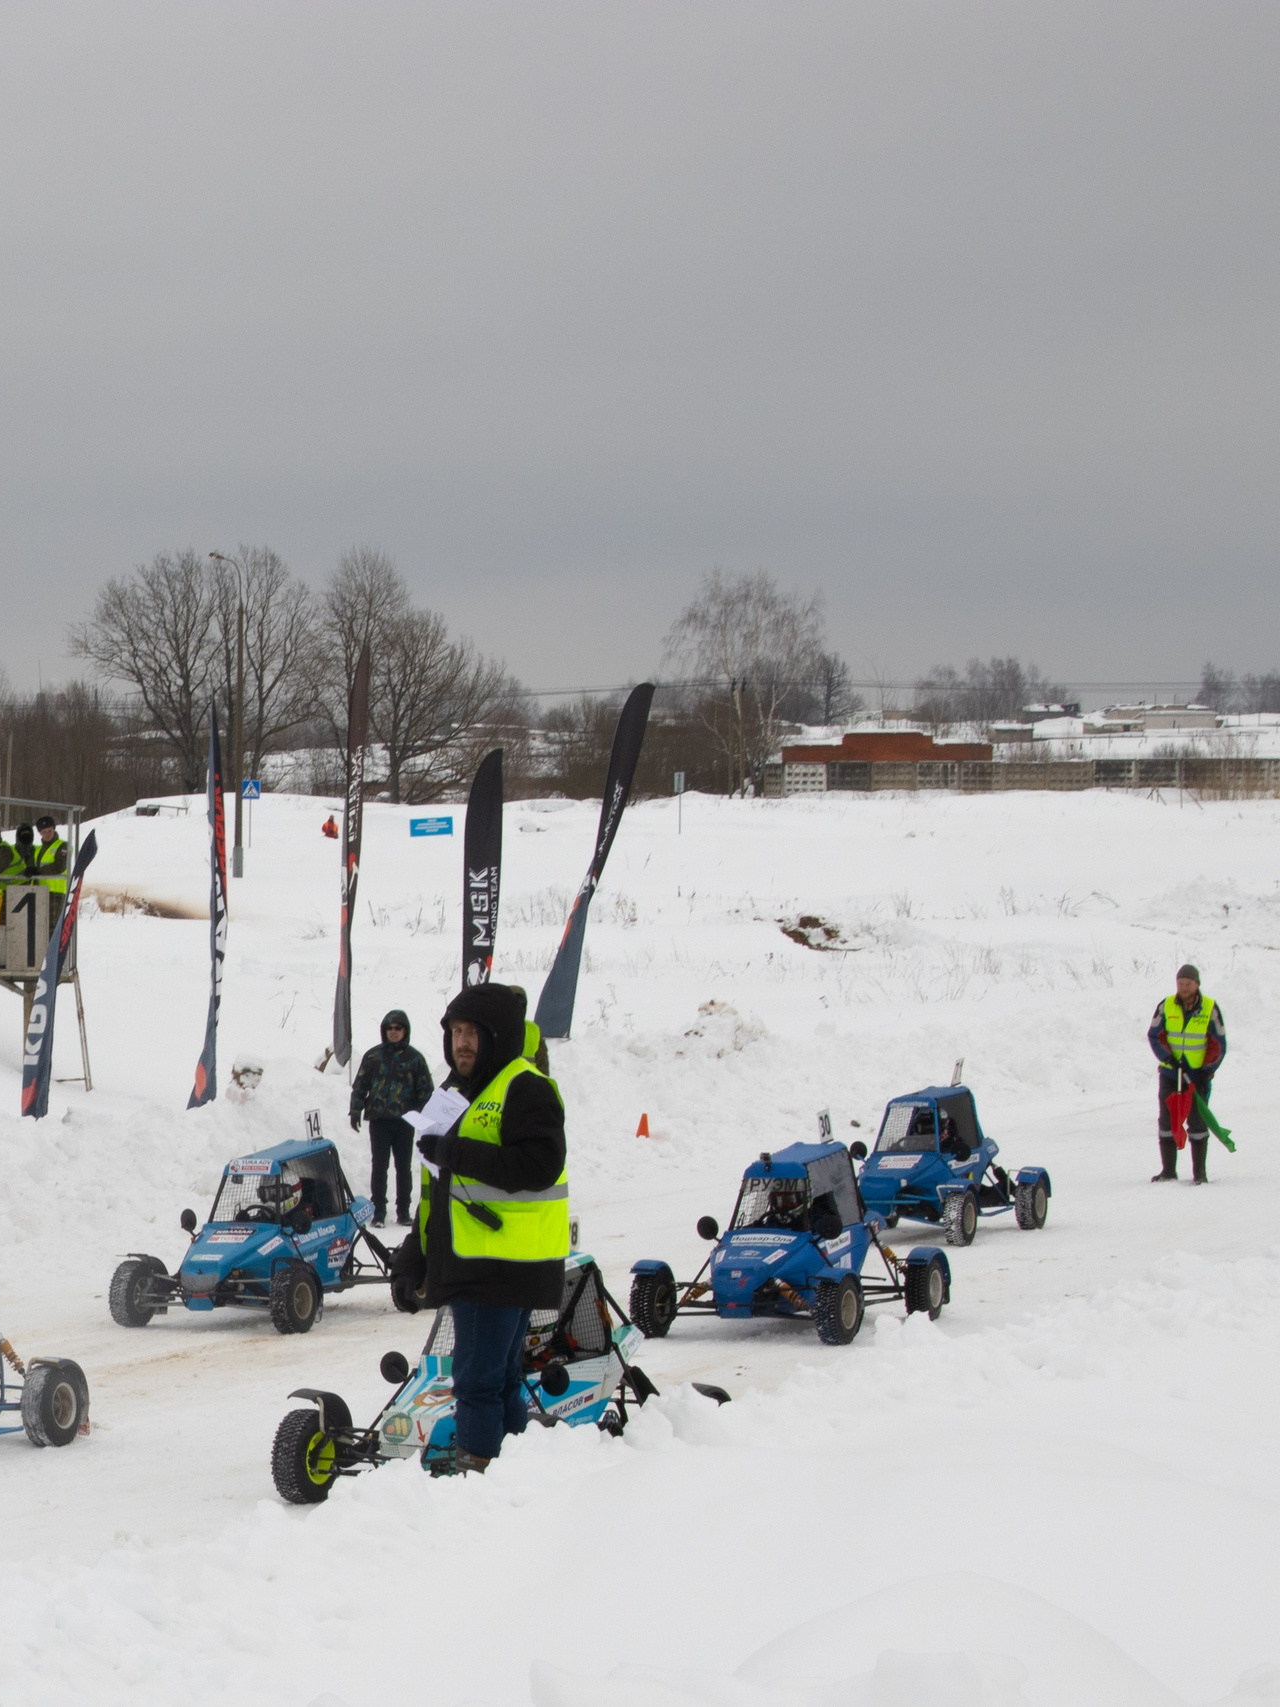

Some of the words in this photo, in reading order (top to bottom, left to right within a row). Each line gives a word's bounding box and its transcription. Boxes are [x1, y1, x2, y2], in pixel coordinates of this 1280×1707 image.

[490, 866, 498, 899] TEAM
[469, 867, 490, 947] MSK
[11, 893, 36, 967] 1
[475, 1101, 502, 1114] RUST
[306, 1112, 321, 1137] 14
[819, 1114, 831, 1137] 30
[749, 1178, 798, 1191] РУЭМ
[731, 1235, 793, 1243] Йошкар-Ола
